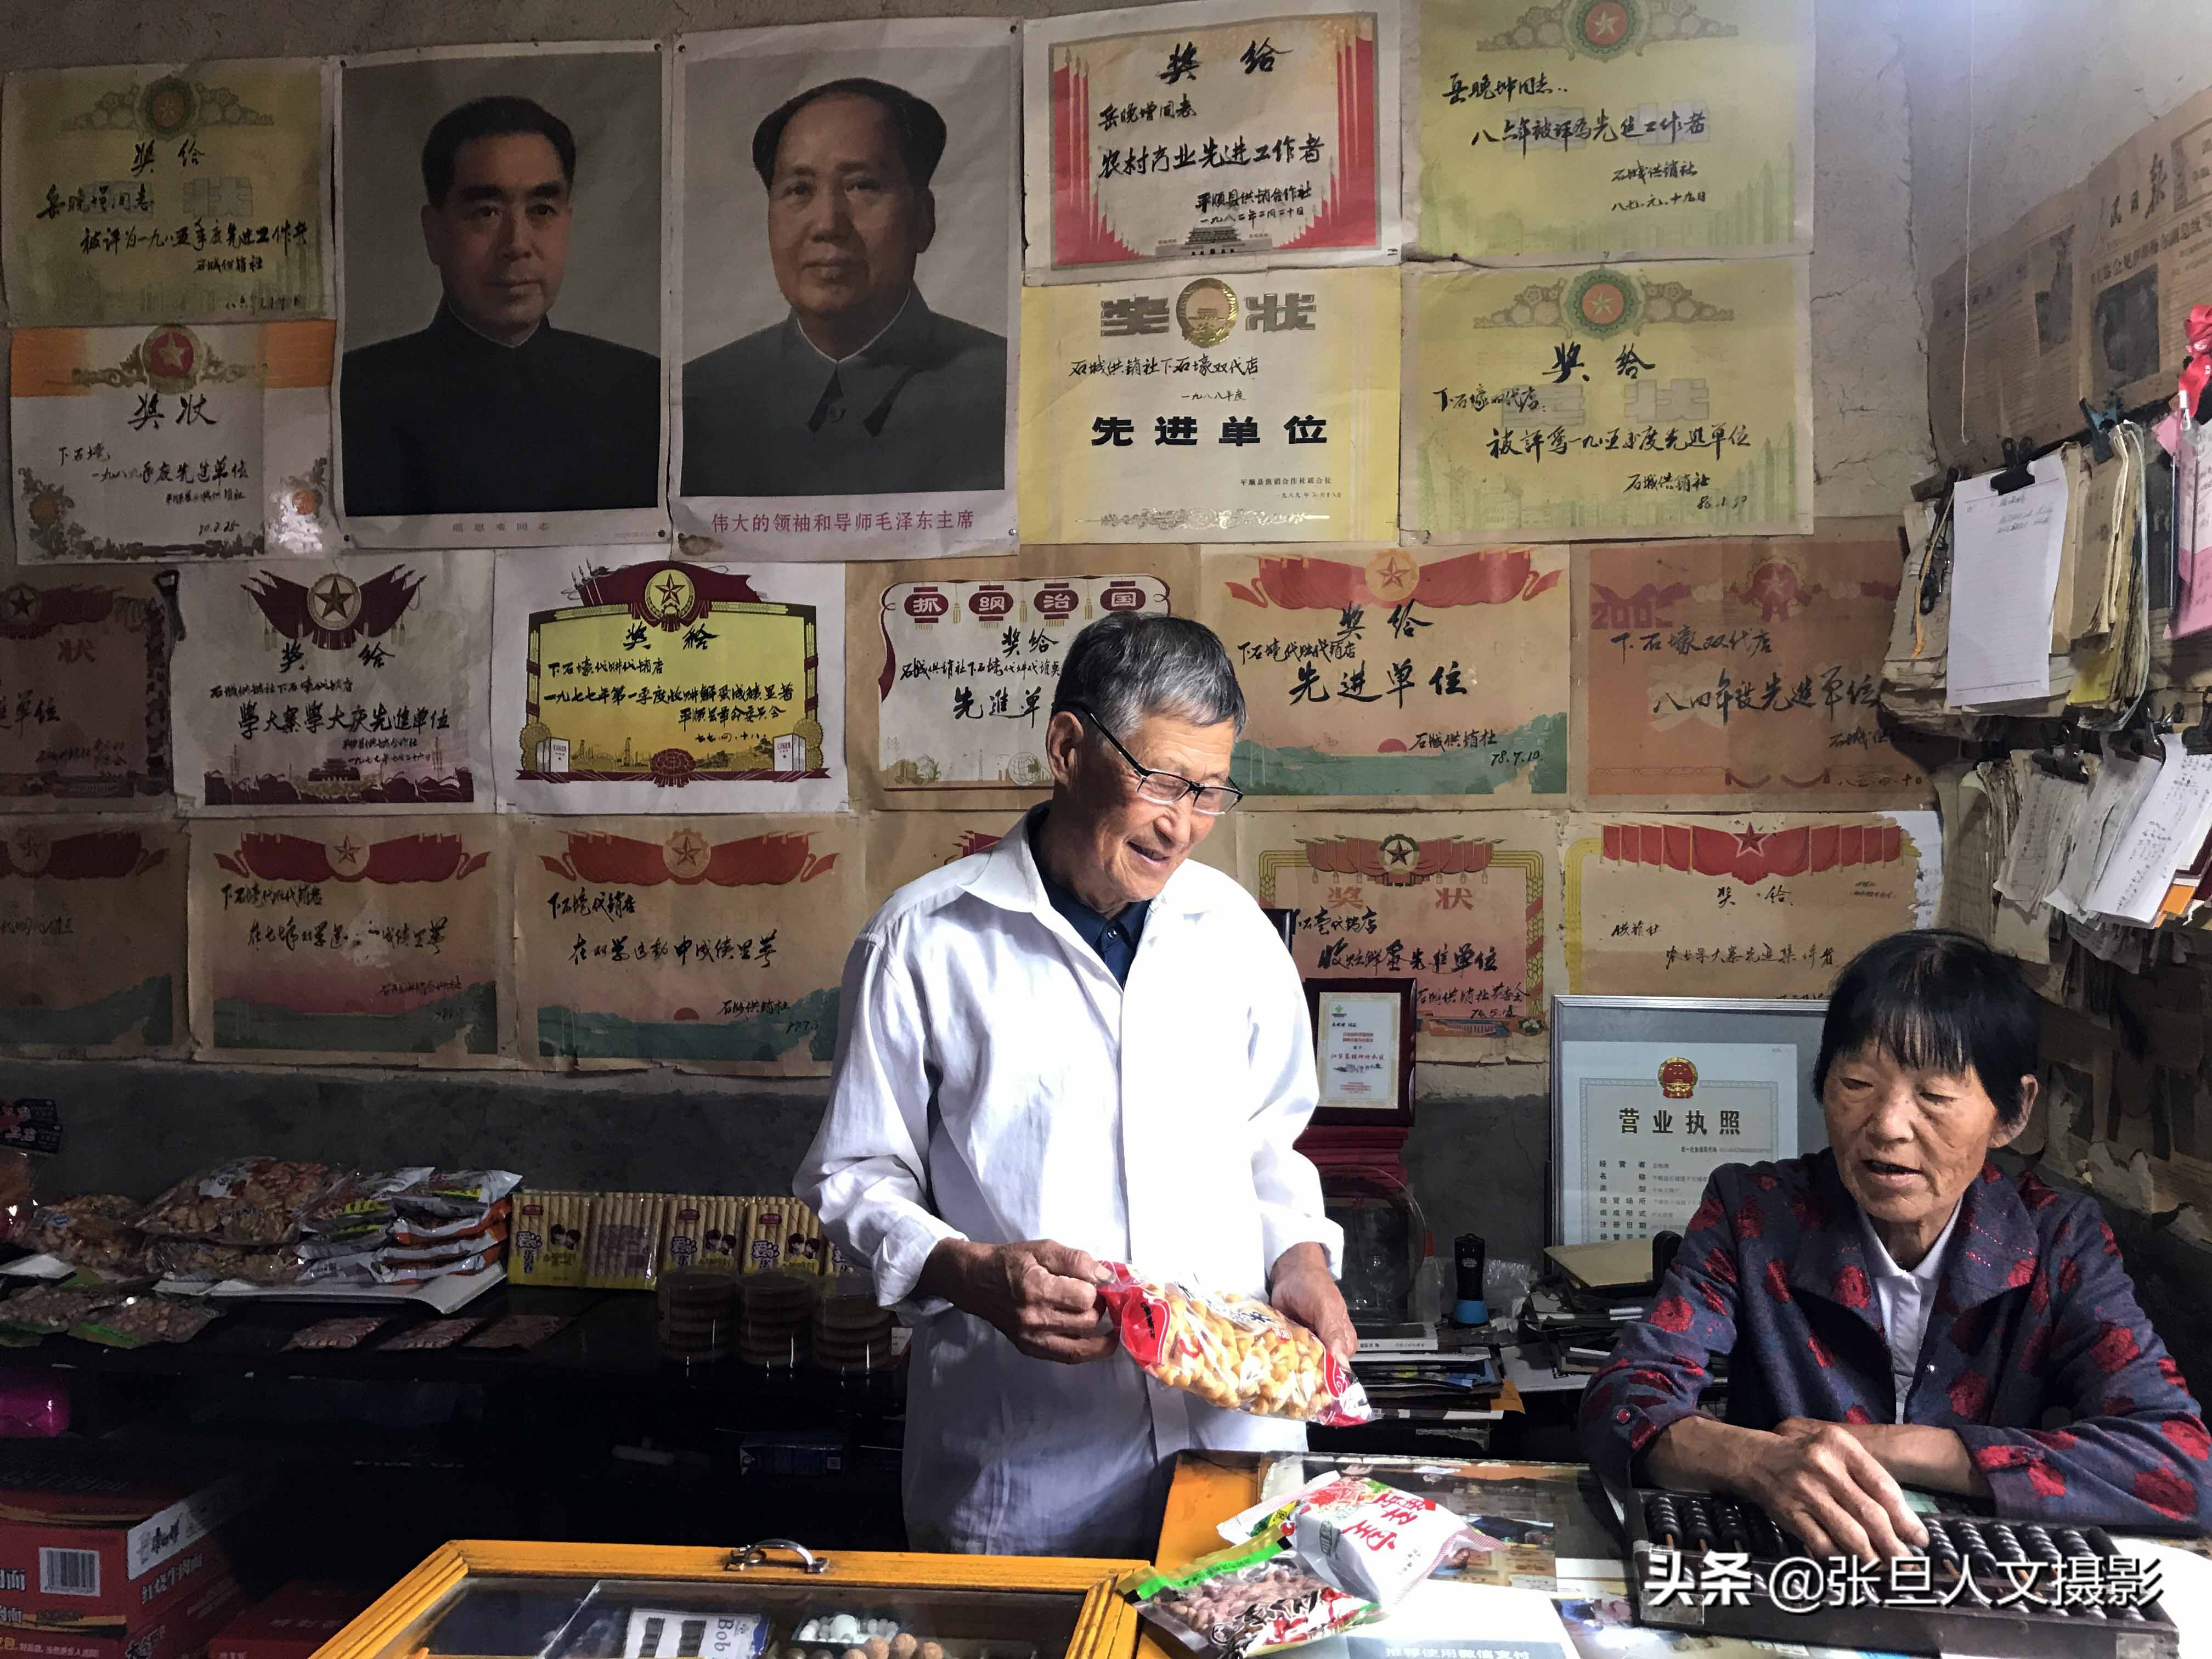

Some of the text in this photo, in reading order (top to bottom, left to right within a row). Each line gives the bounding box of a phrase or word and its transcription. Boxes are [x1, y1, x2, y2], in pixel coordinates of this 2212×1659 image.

[1091, 415, 1328, 447] 先进单位
[712, 510, 974, 533] 伟大的领袖和导师毛泽东主席
[913, 591, 1137, 613] 抓纲治国
[1327, 886, 1474, 911] 奖状
[1619, 1108, 1741, 1135] 营业执照
